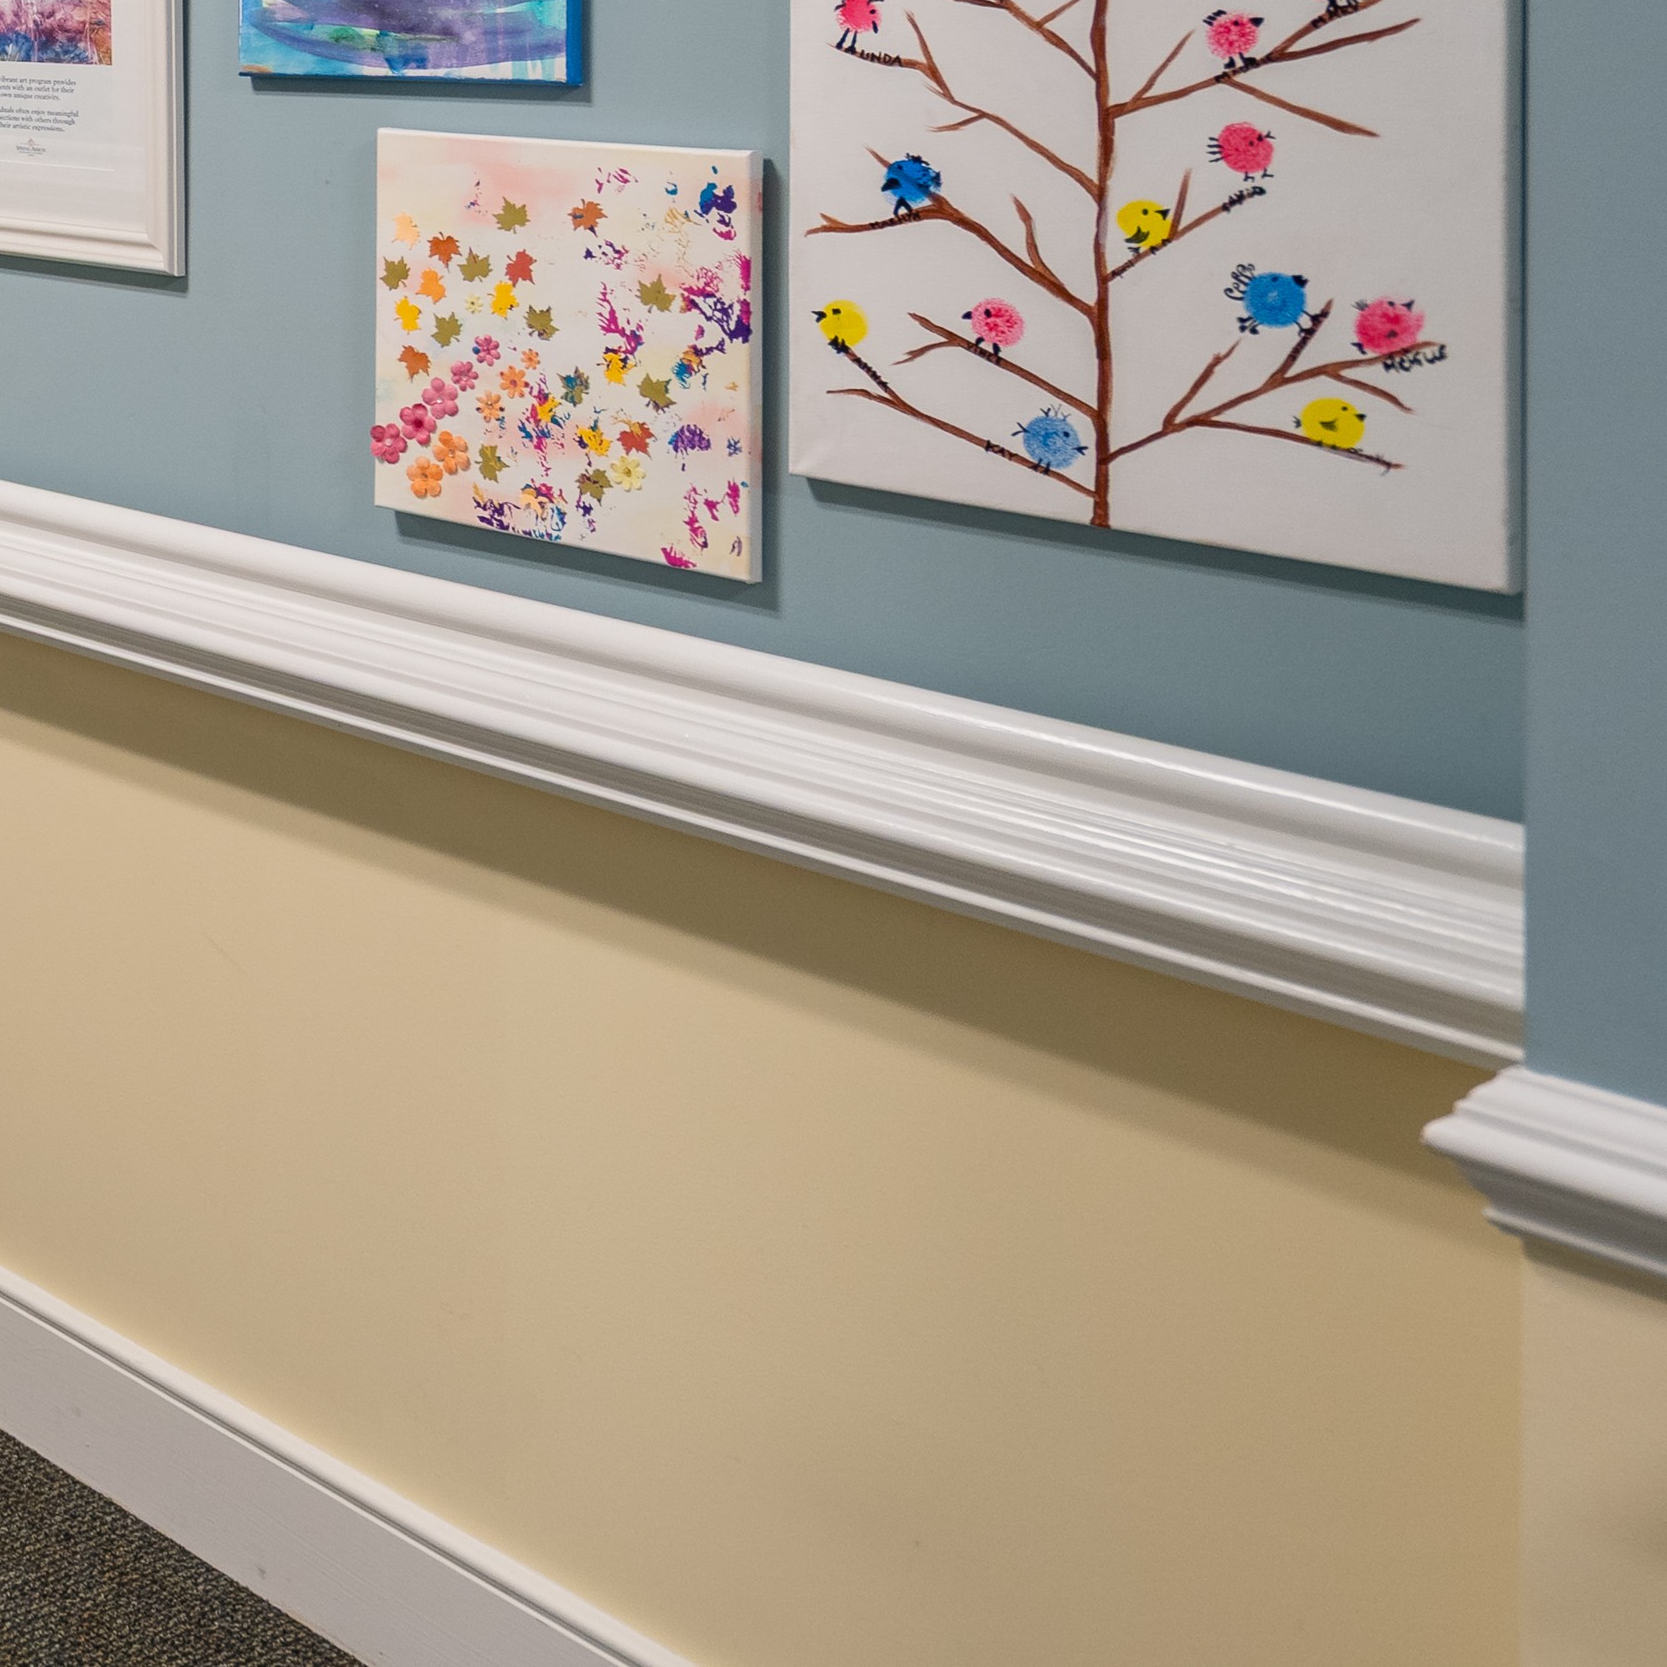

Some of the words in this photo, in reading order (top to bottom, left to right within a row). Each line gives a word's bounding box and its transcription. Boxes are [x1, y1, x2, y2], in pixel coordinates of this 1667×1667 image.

[28, 78, 51, 86] program
[61, 86, 75, 94] their
[46, 110, 79, 118] meaningful
[34, 116, 51, 124] others
[52, 117, 76, 126] through
